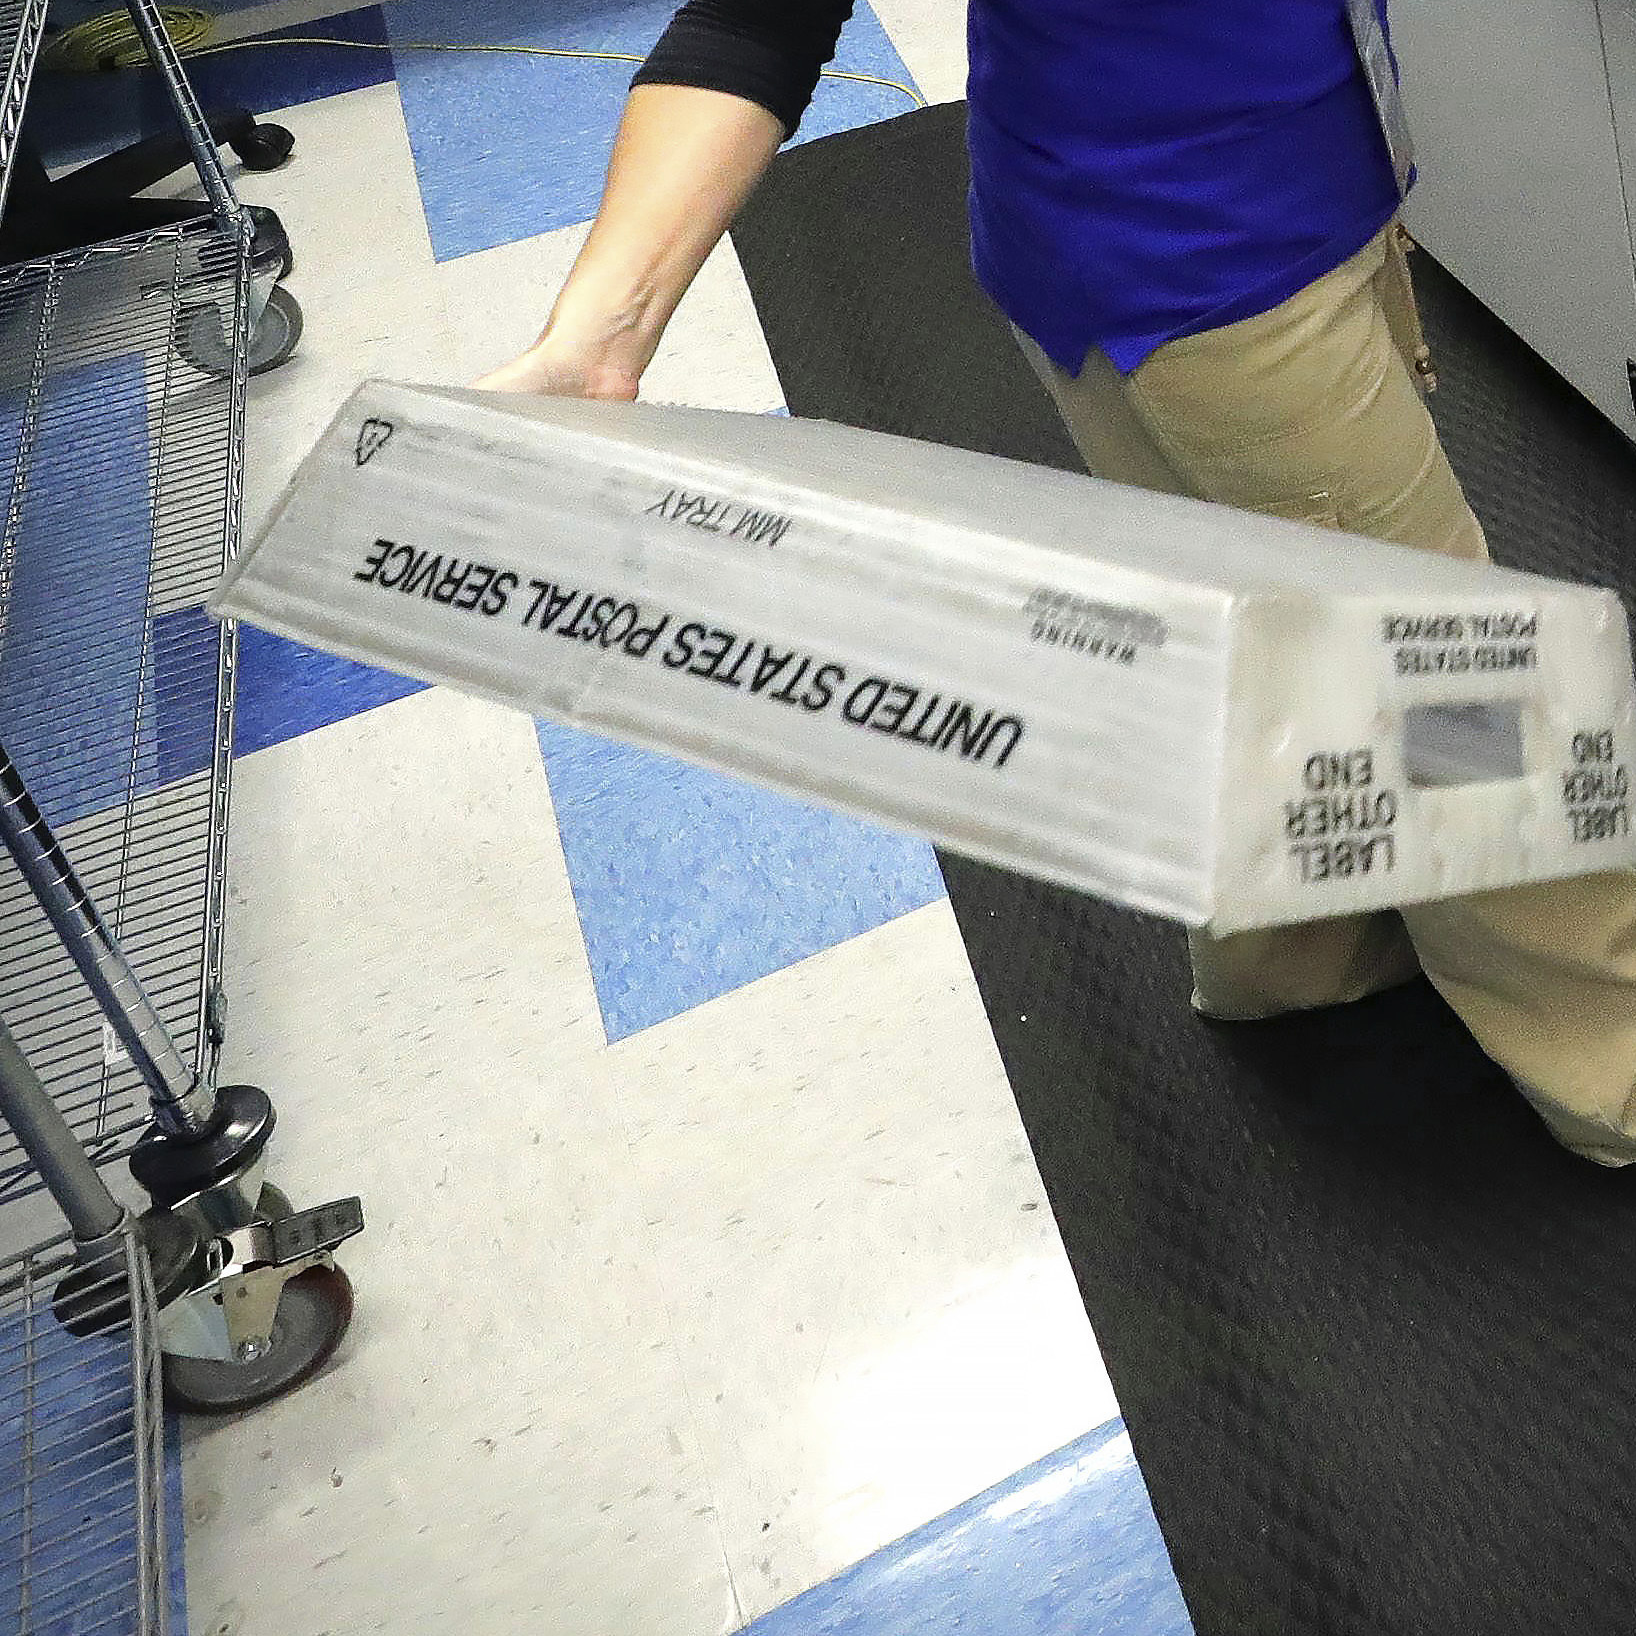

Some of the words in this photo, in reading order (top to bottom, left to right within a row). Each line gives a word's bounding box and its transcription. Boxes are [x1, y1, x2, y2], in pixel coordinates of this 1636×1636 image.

[645, 488, 731, 536] TRAY
[353, 537, 521, 618] SERVICE
[521, 577, 675, 664] POSTAL
[661, 619, 848, 714] STATES
[840, 672, 1024, 770] UNITED
[1302, 748, 1373, 791] END
[1285, 788, 1397, 840] OTHER
[1292, 834, 1395, 884] LABEL
